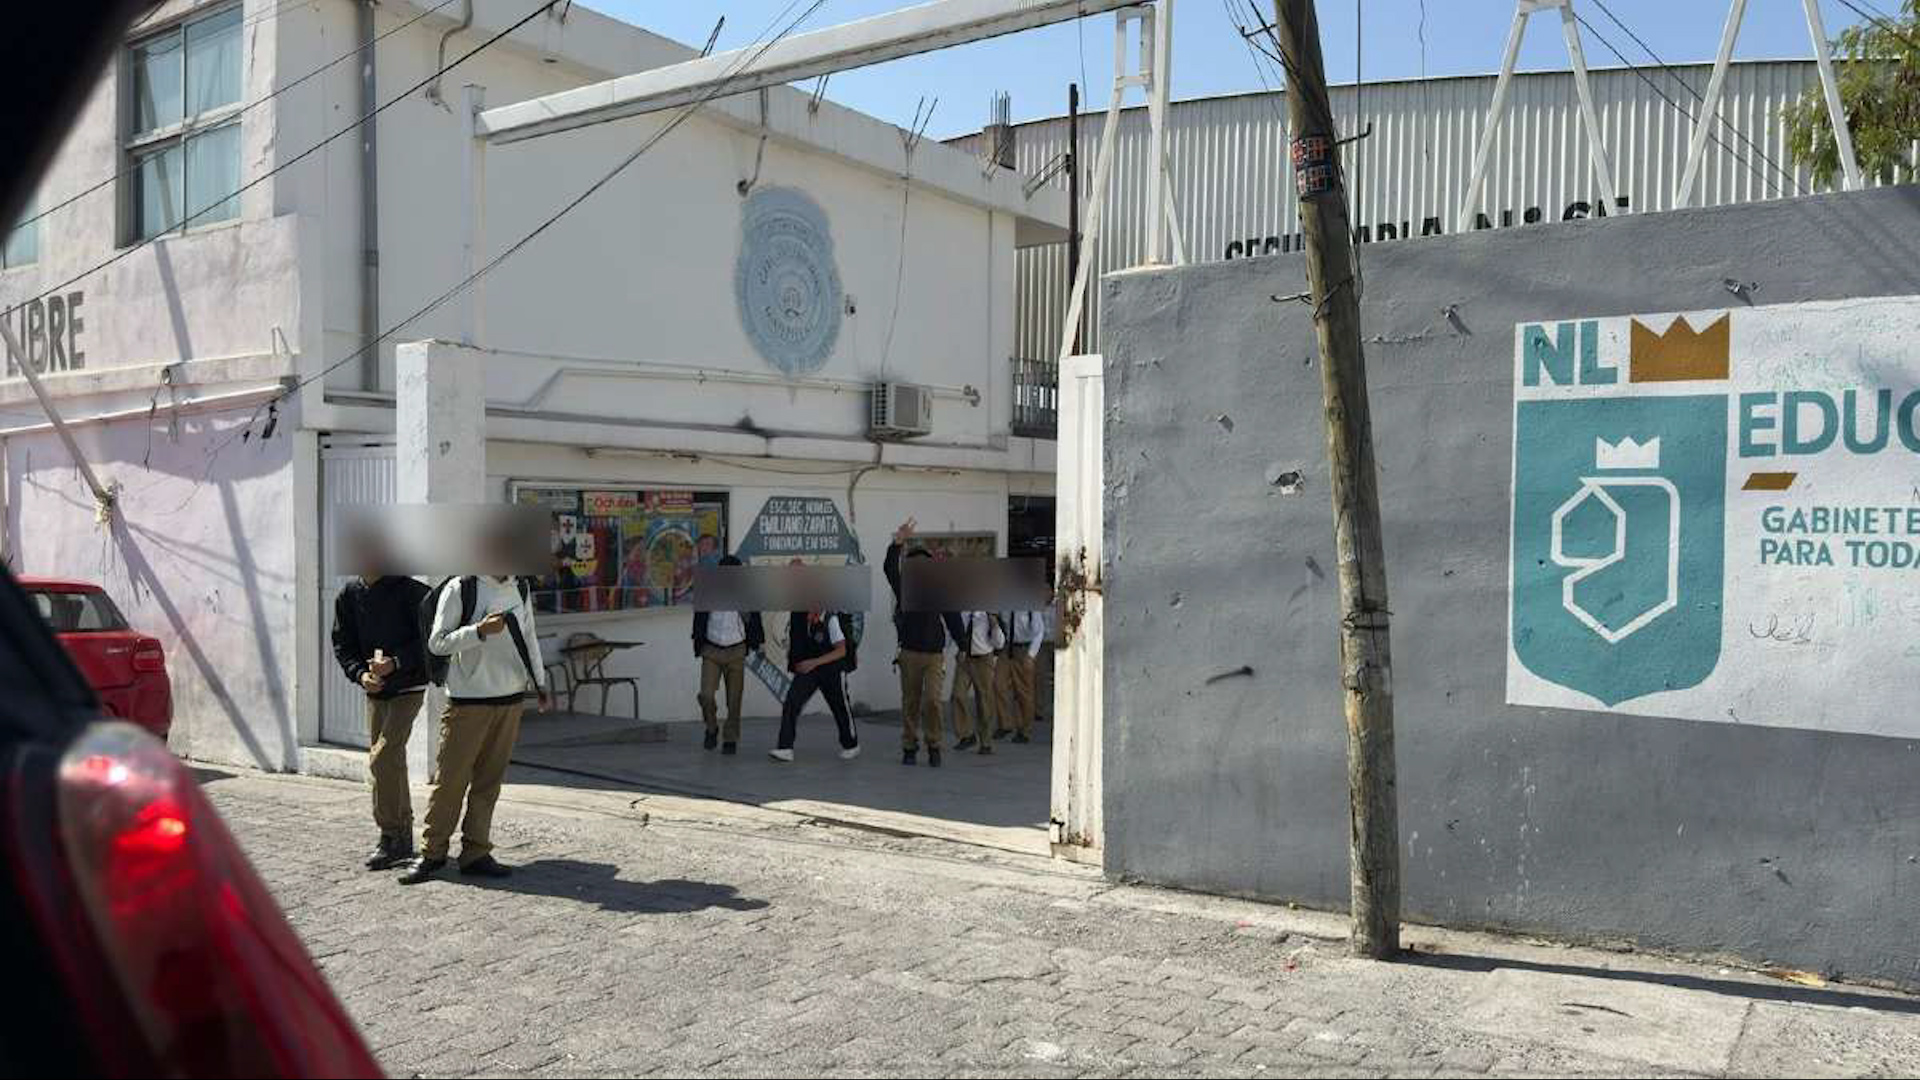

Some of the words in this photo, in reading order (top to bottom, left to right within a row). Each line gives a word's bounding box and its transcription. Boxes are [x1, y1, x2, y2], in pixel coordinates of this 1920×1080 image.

[6, 291, 84, 377] LIBRE
[1523, 321, 1618, 387] NL
[760, 515, 804, 535] EMILIANO
[804, 515, 839, 535] ZAPATA
[1761, 505, 1920, 534] GABINETE
[1760, 539, 1835, 567] PARA
